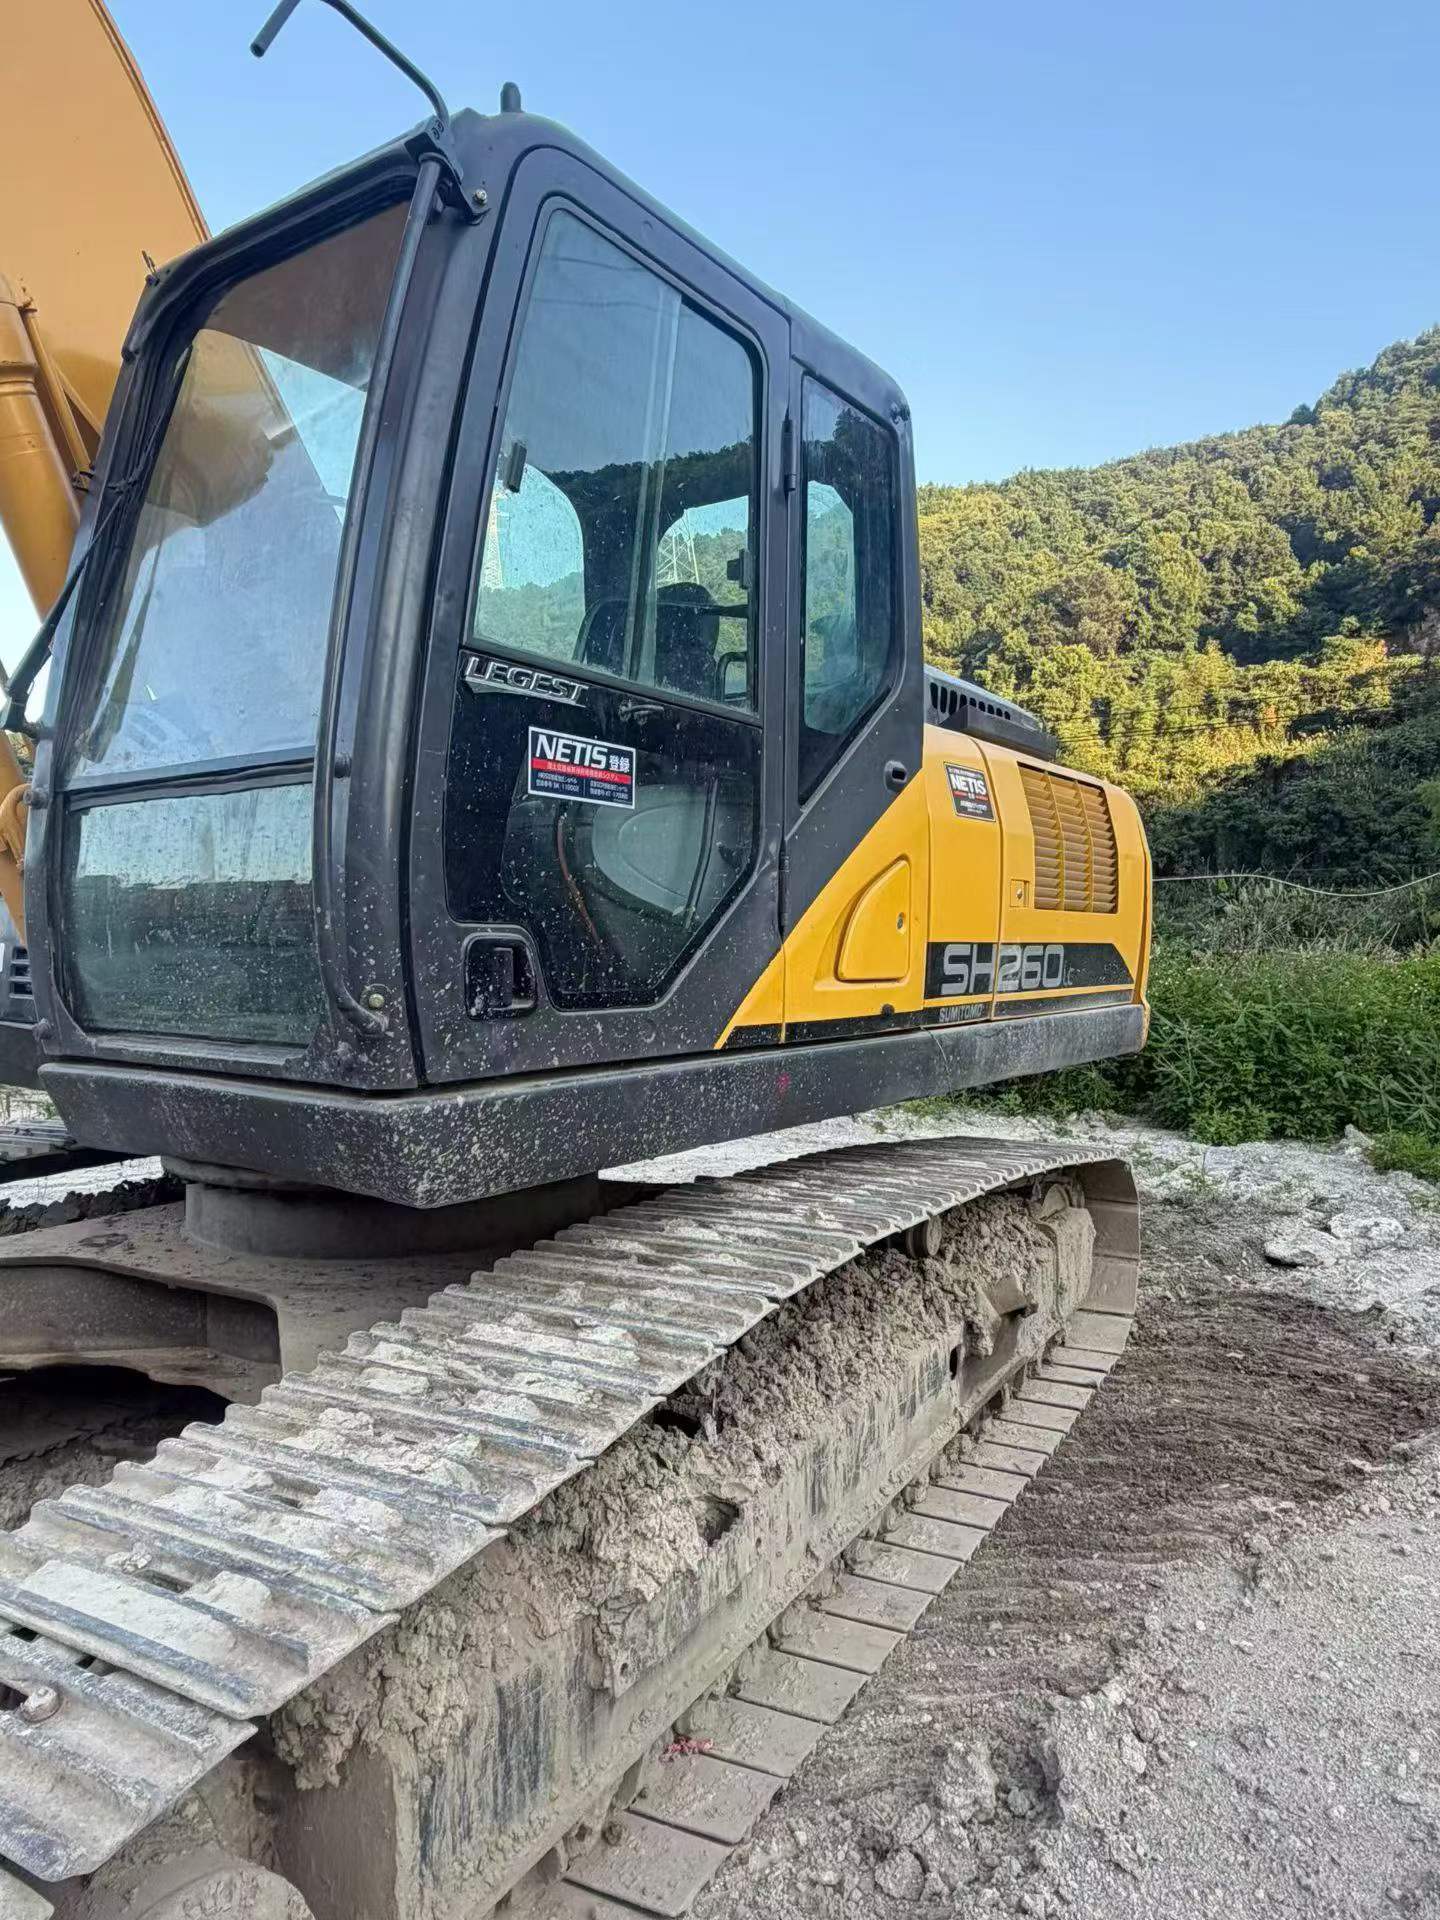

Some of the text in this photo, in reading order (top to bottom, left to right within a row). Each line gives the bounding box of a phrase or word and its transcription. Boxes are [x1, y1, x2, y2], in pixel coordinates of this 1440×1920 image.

[465, 656, 589, 701] LEGEST
[535, 734, 608, 769] NETIS
[949, 773, 987, 795] NETIS
